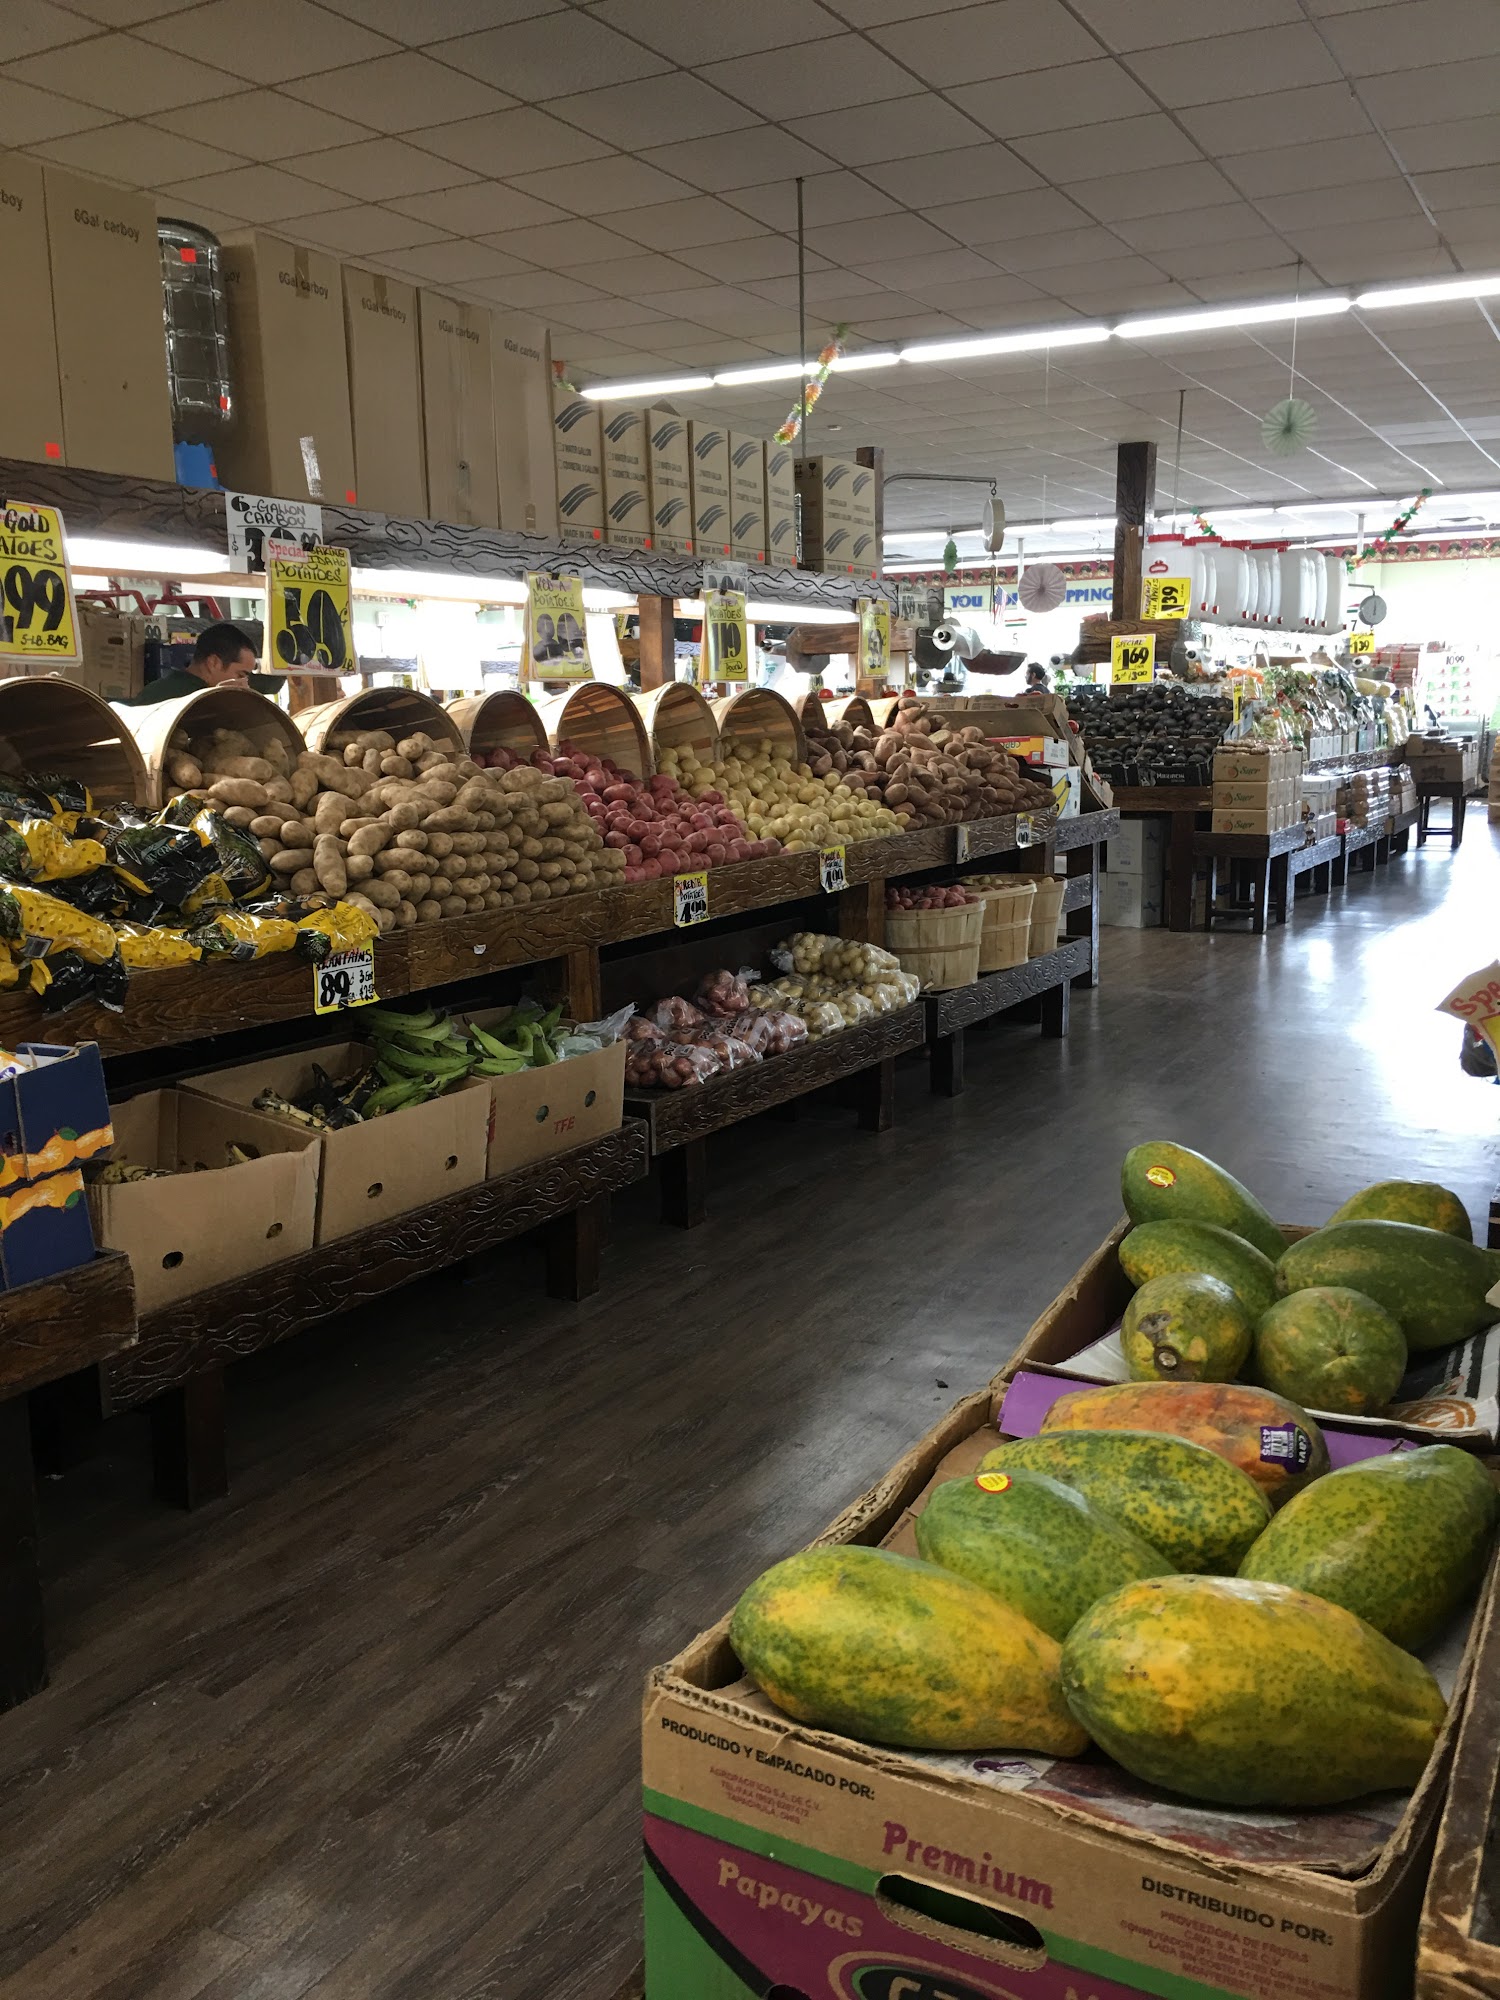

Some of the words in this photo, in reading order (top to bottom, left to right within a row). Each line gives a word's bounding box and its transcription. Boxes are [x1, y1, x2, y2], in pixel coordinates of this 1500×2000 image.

[0, 187, 24, 212] boy
[73, 208, 100, 227] 6Gal
[103, 218, 140, 243] carboy
[278, 270, 300, 288] 6Gal
[300, 276, 329, 300] carboy
[381, 303, 407, 324] carboy
[455, 325, 480, 344] carboy
[243, 511, 306, 528] CARBOY
[268, 539, 306, 561] Special
[275, 560, 342, 583] POTATOES
[532, 588, 575, 607] POTATOES
[950, 595, 983, 608] YOU
[1350, 619, 1358, 632] 7
[553, 1115, 576, 1135] TFE
[661, 1717, 741, 1758] PRODUCIDO
[744, 1744, 753, 1759] Y
[755, 1750, 836, 1788] EMPACADO
[839, 1777, 875, 1801] POR:
[882, 1820, 1055, 1910] Premium
[717, 1857, 865, 1938] Papayas
[1141, 1876, 1274, 1929] DISTRIBUIDO
[1280, 1918, 1334, 1947] POR:
